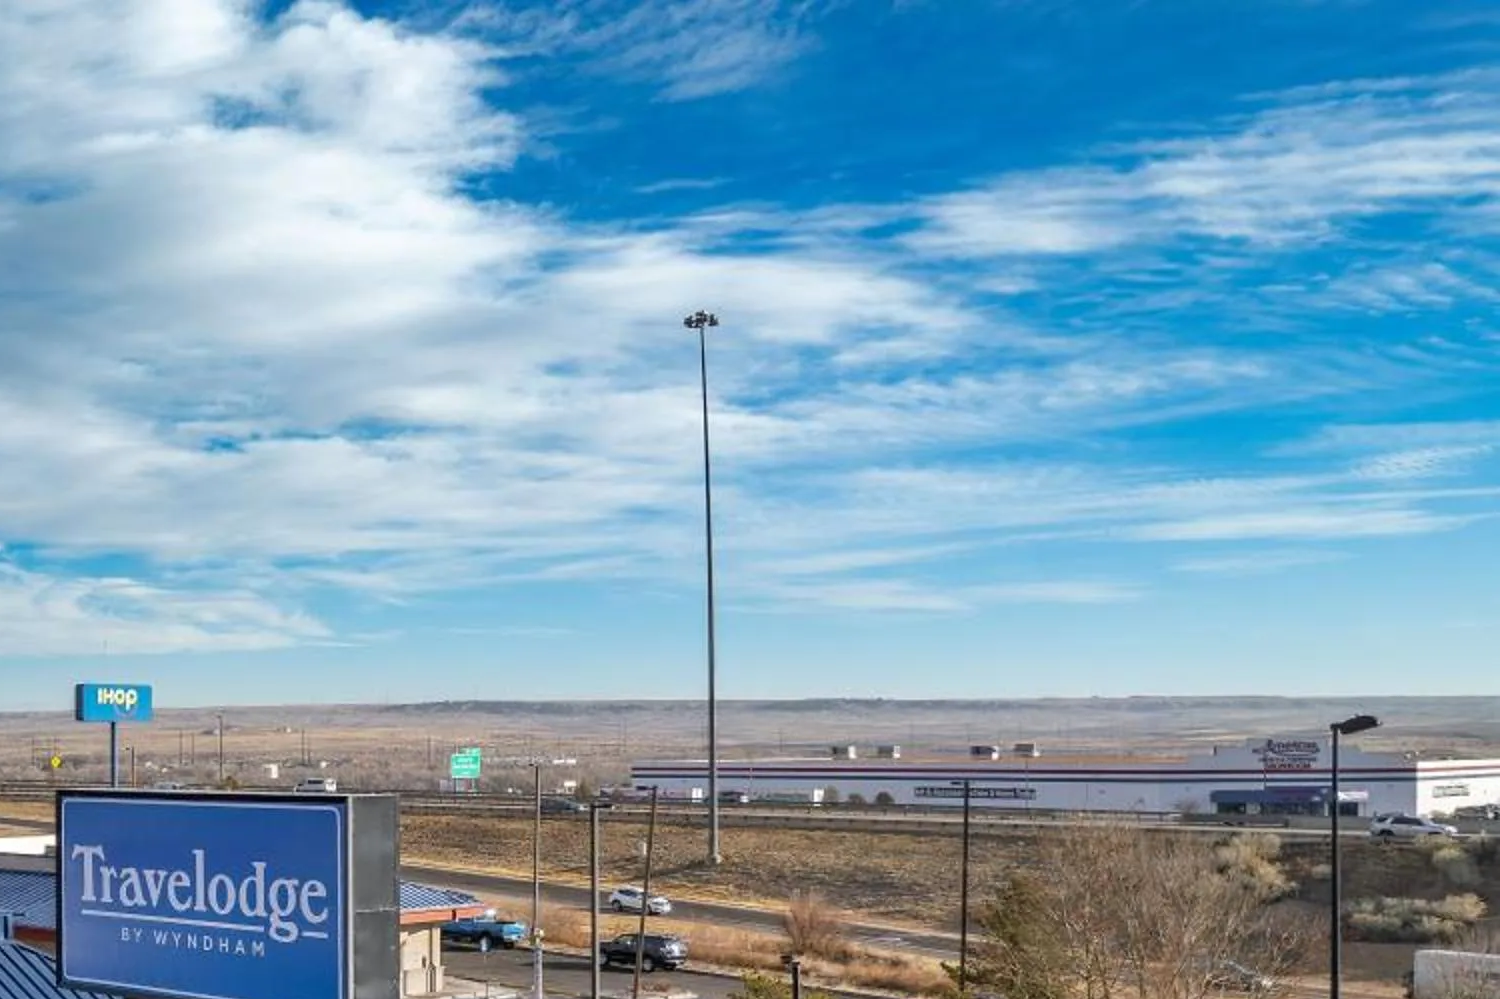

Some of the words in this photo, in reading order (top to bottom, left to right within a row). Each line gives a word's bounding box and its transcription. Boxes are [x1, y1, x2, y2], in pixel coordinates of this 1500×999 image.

[71, 844, 329, 943] Travelodge
[120, 927, 143, 943] BY
[153, 929, 265, 957] WYNDHAM
